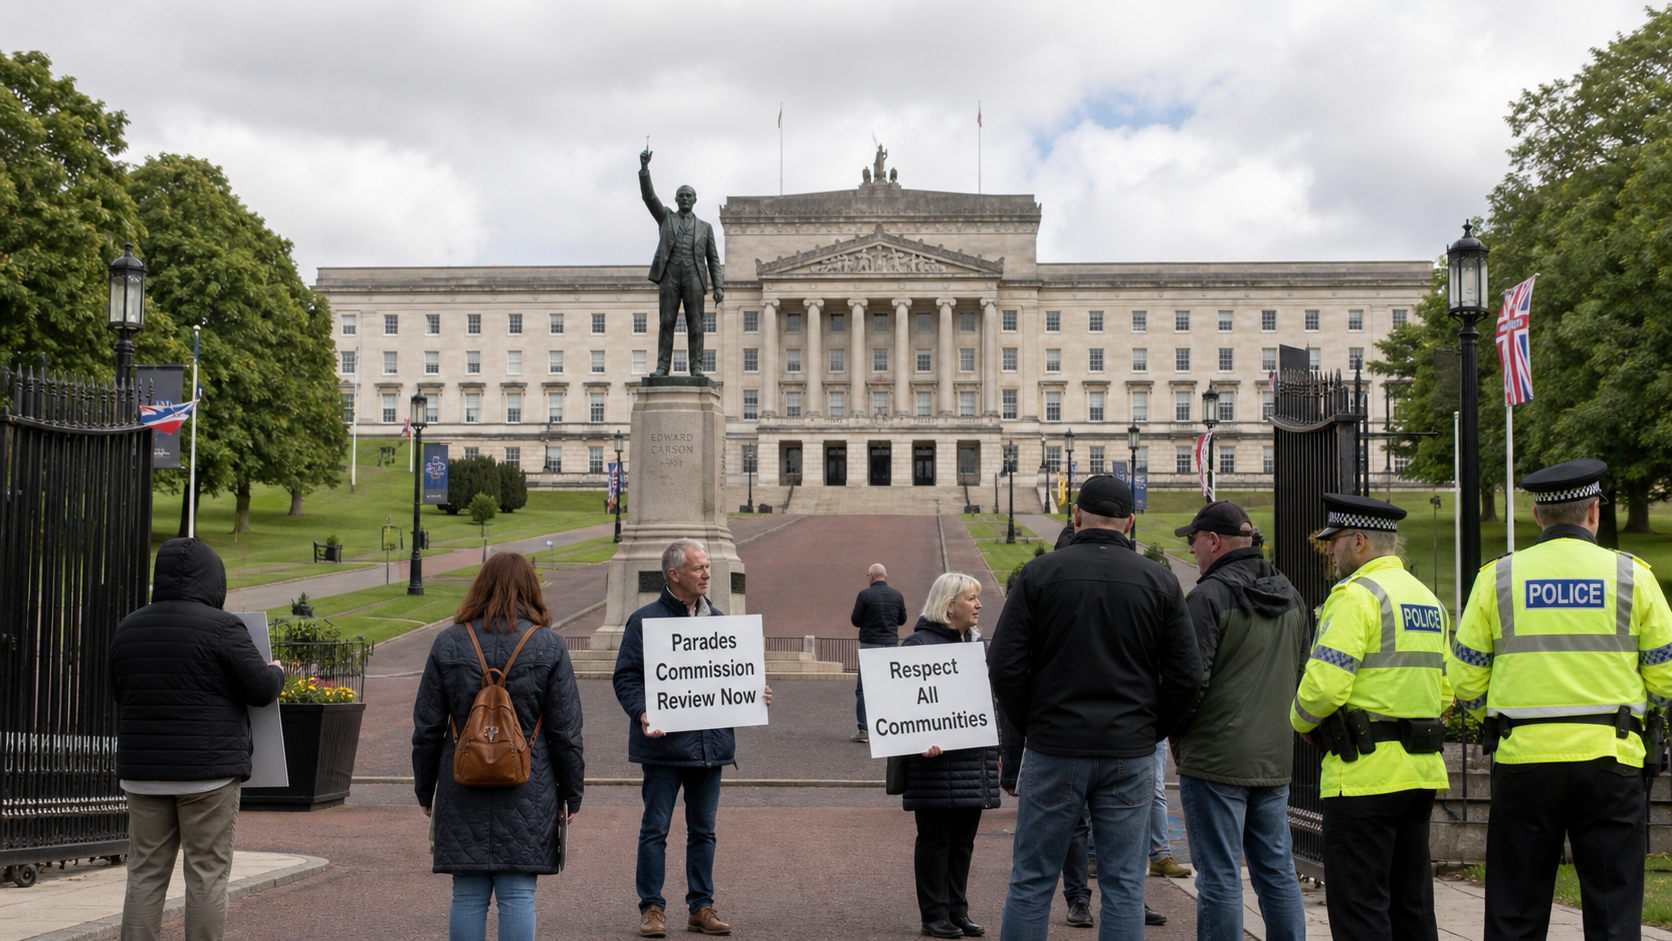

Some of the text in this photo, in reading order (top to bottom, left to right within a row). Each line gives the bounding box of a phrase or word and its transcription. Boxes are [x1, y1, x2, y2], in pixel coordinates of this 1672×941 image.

[651, 433, 694, 442] EDWARD
[651, 445, 694, 454] CARSON
[1529, 583, 1602, 604] POLICE
[1403, 607, 1441, 629] POLICE
[672, 631, 737, 651] Parades
[656, 659, 755, 681] Commission
[889, 658, 959, 681] Respect
[657, 688, 756, 710] Review Now
[917, 686, 939, 705] All
[875, 711, 988, 736] Communities
